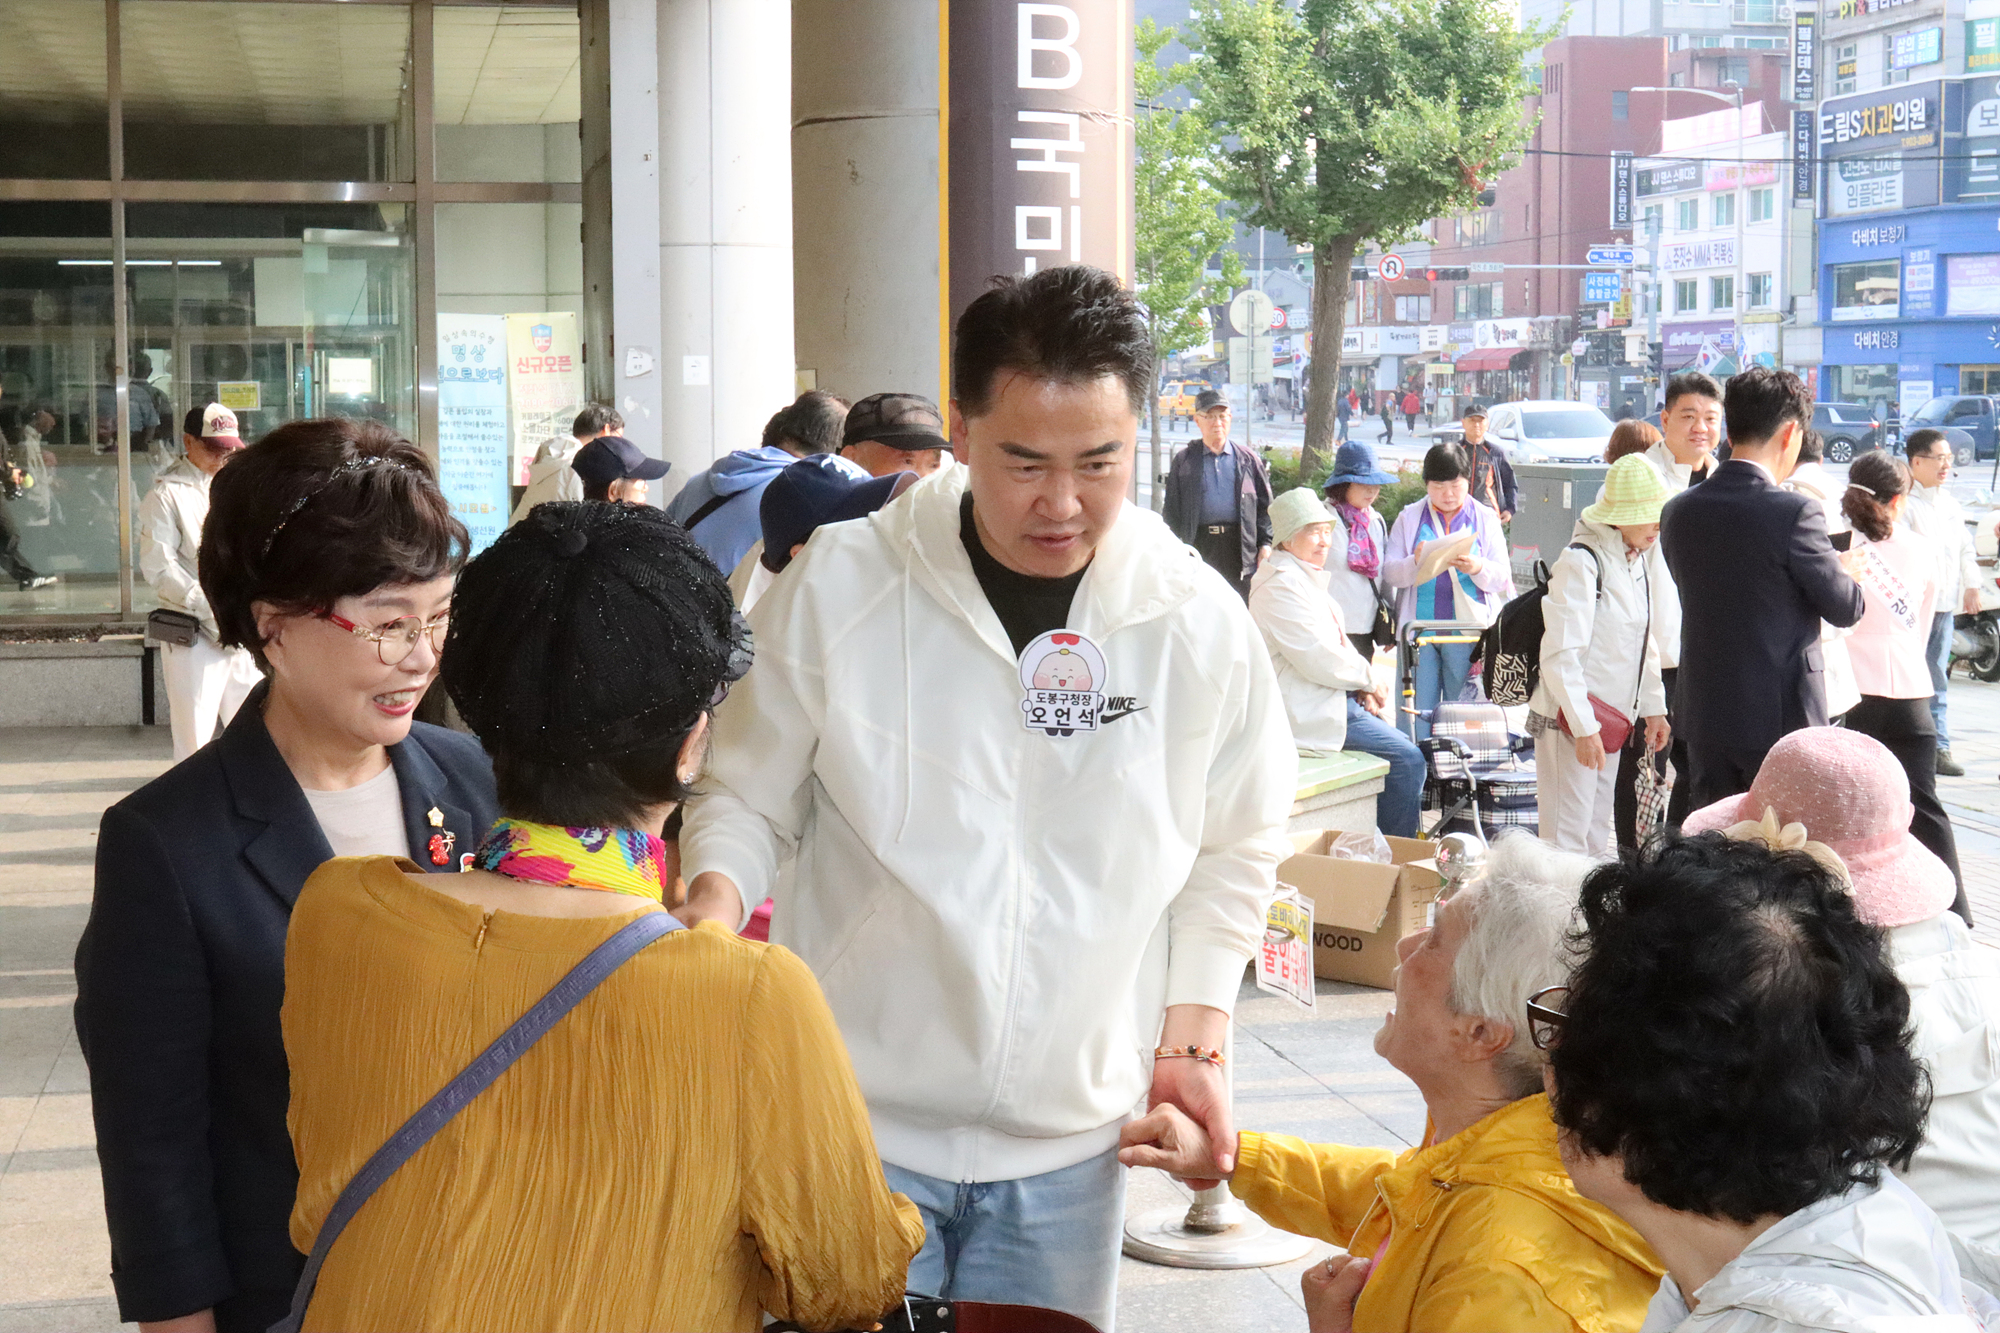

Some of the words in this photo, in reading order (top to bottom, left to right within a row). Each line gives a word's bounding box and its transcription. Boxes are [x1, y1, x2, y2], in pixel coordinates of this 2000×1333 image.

[1897, 35, 1915, 55] 삶의
[1797, 27, 1812, 83] 필라테스
[1820, 98, 1926, 144] 드림S치과의원
[1661, 171, 1672, 185] 댄스
[1673, 166, 1696, 183] 스튜디오
[1847, 180, 1897, 209] 임플란트
[452, 344, 486, 363] 명상
[517, 355, 573, 374] 신규오픈
[1036, 692, 1092, 706] 도봉구청장
[1106, 697, 1136, 711] NIKE
[1030, 707, 1095, 728] 오언석
